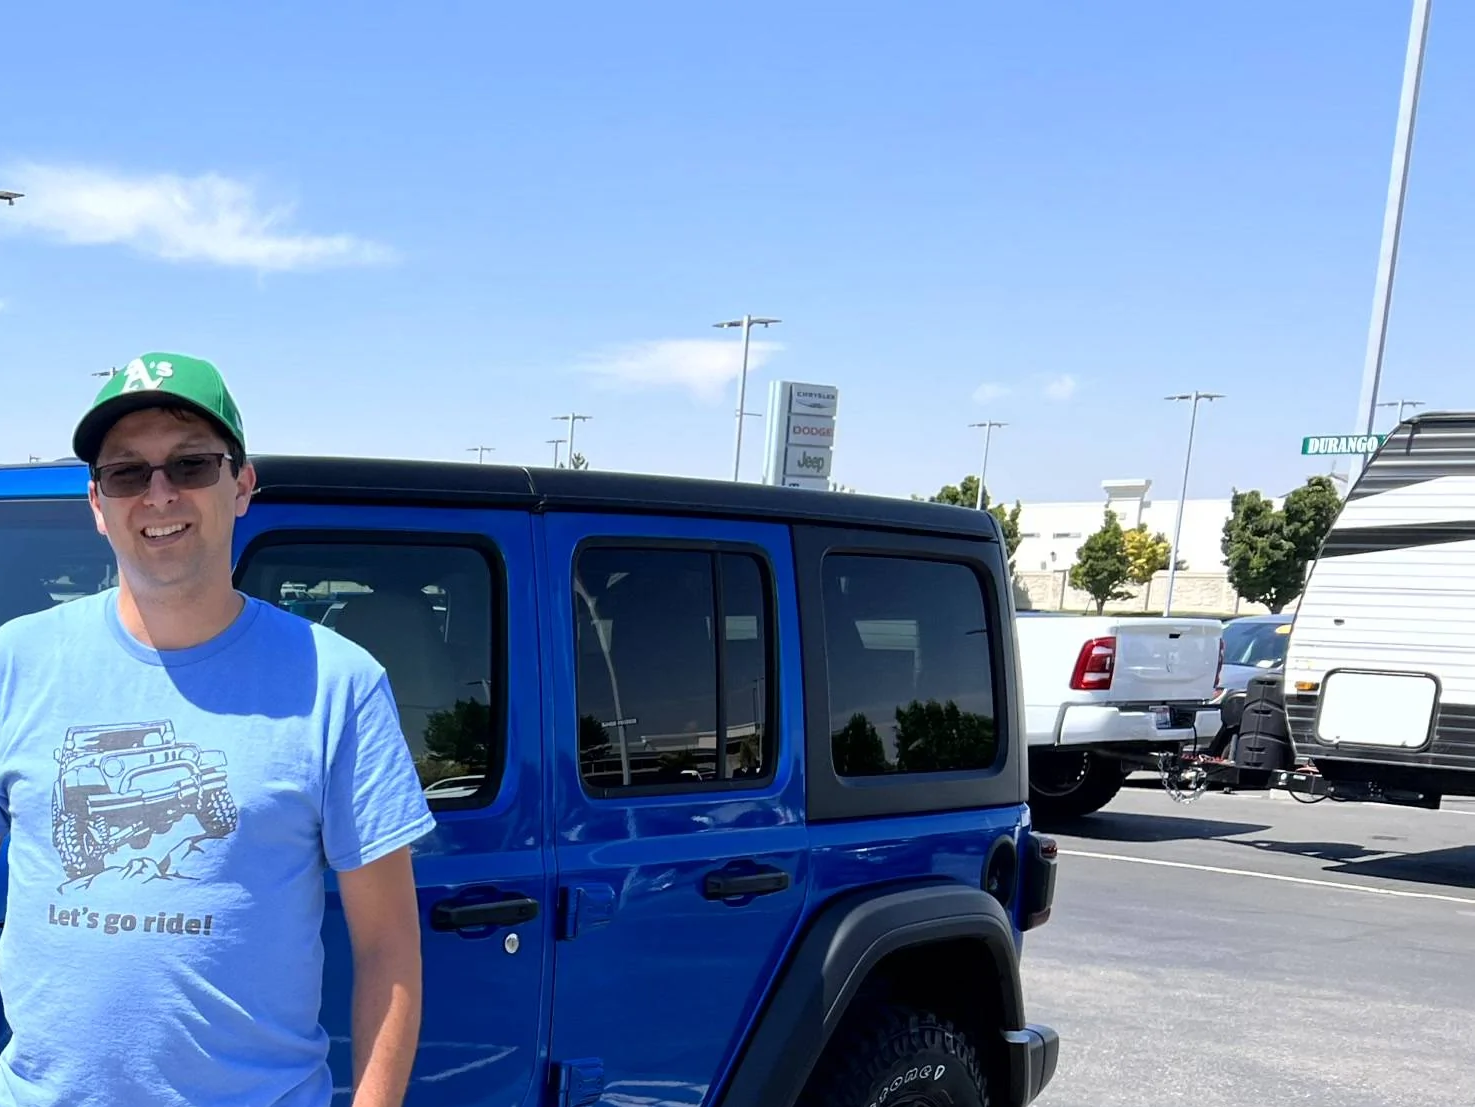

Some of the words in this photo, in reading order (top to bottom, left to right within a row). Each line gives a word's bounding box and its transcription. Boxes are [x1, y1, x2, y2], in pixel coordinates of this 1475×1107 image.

[796, 391, 835, 400] CHRYSLER
[792, 425, 833, 437] DODGE
[1307, 436, 1379, 453] DURANGO
[797, 451, 824, 472] Jeep
[49, 904, 99, 929] Let's
[103, 913, 137, 935] go
[143, 912, 213, 936] ride!
